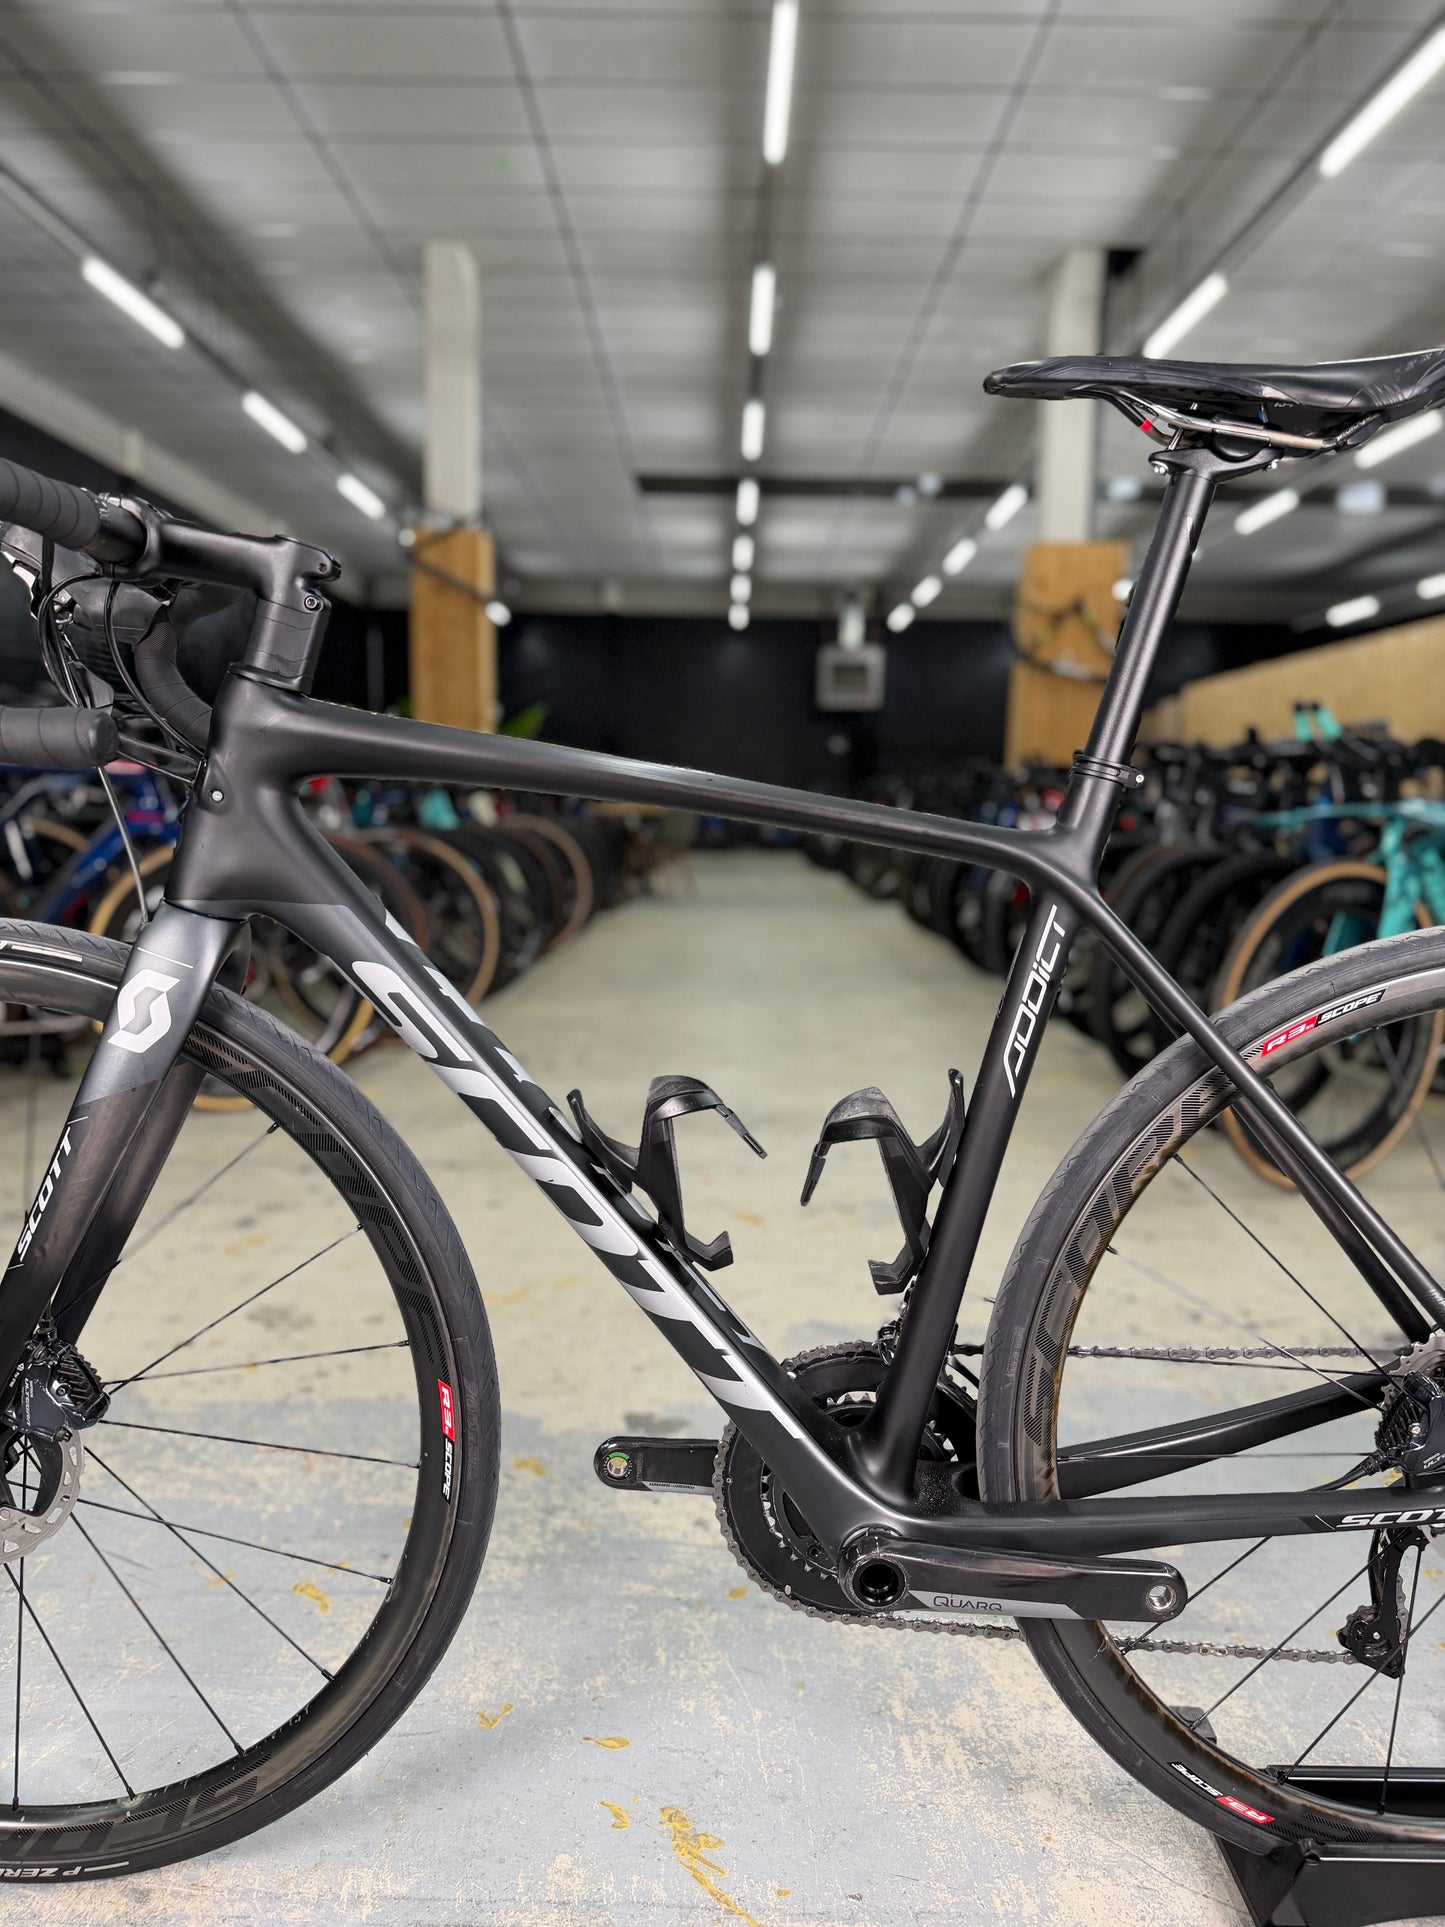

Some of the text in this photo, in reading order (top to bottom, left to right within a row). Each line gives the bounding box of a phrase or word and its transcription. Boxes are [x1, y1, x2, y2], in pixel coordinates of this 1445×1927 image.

[1317, 991, 1383, 1025] SCOPE
[17, 1126, 72, 1263] SCOTT
[351, 960, 806, 1440] SCOTT
[442, 1437, 453, 1501] SCOPE
[933, 1594, 1003, 1611] QUARQ
[1171, 1762, 1224, 1797] SCOPE
[62, 1865, 82, 1877] P
